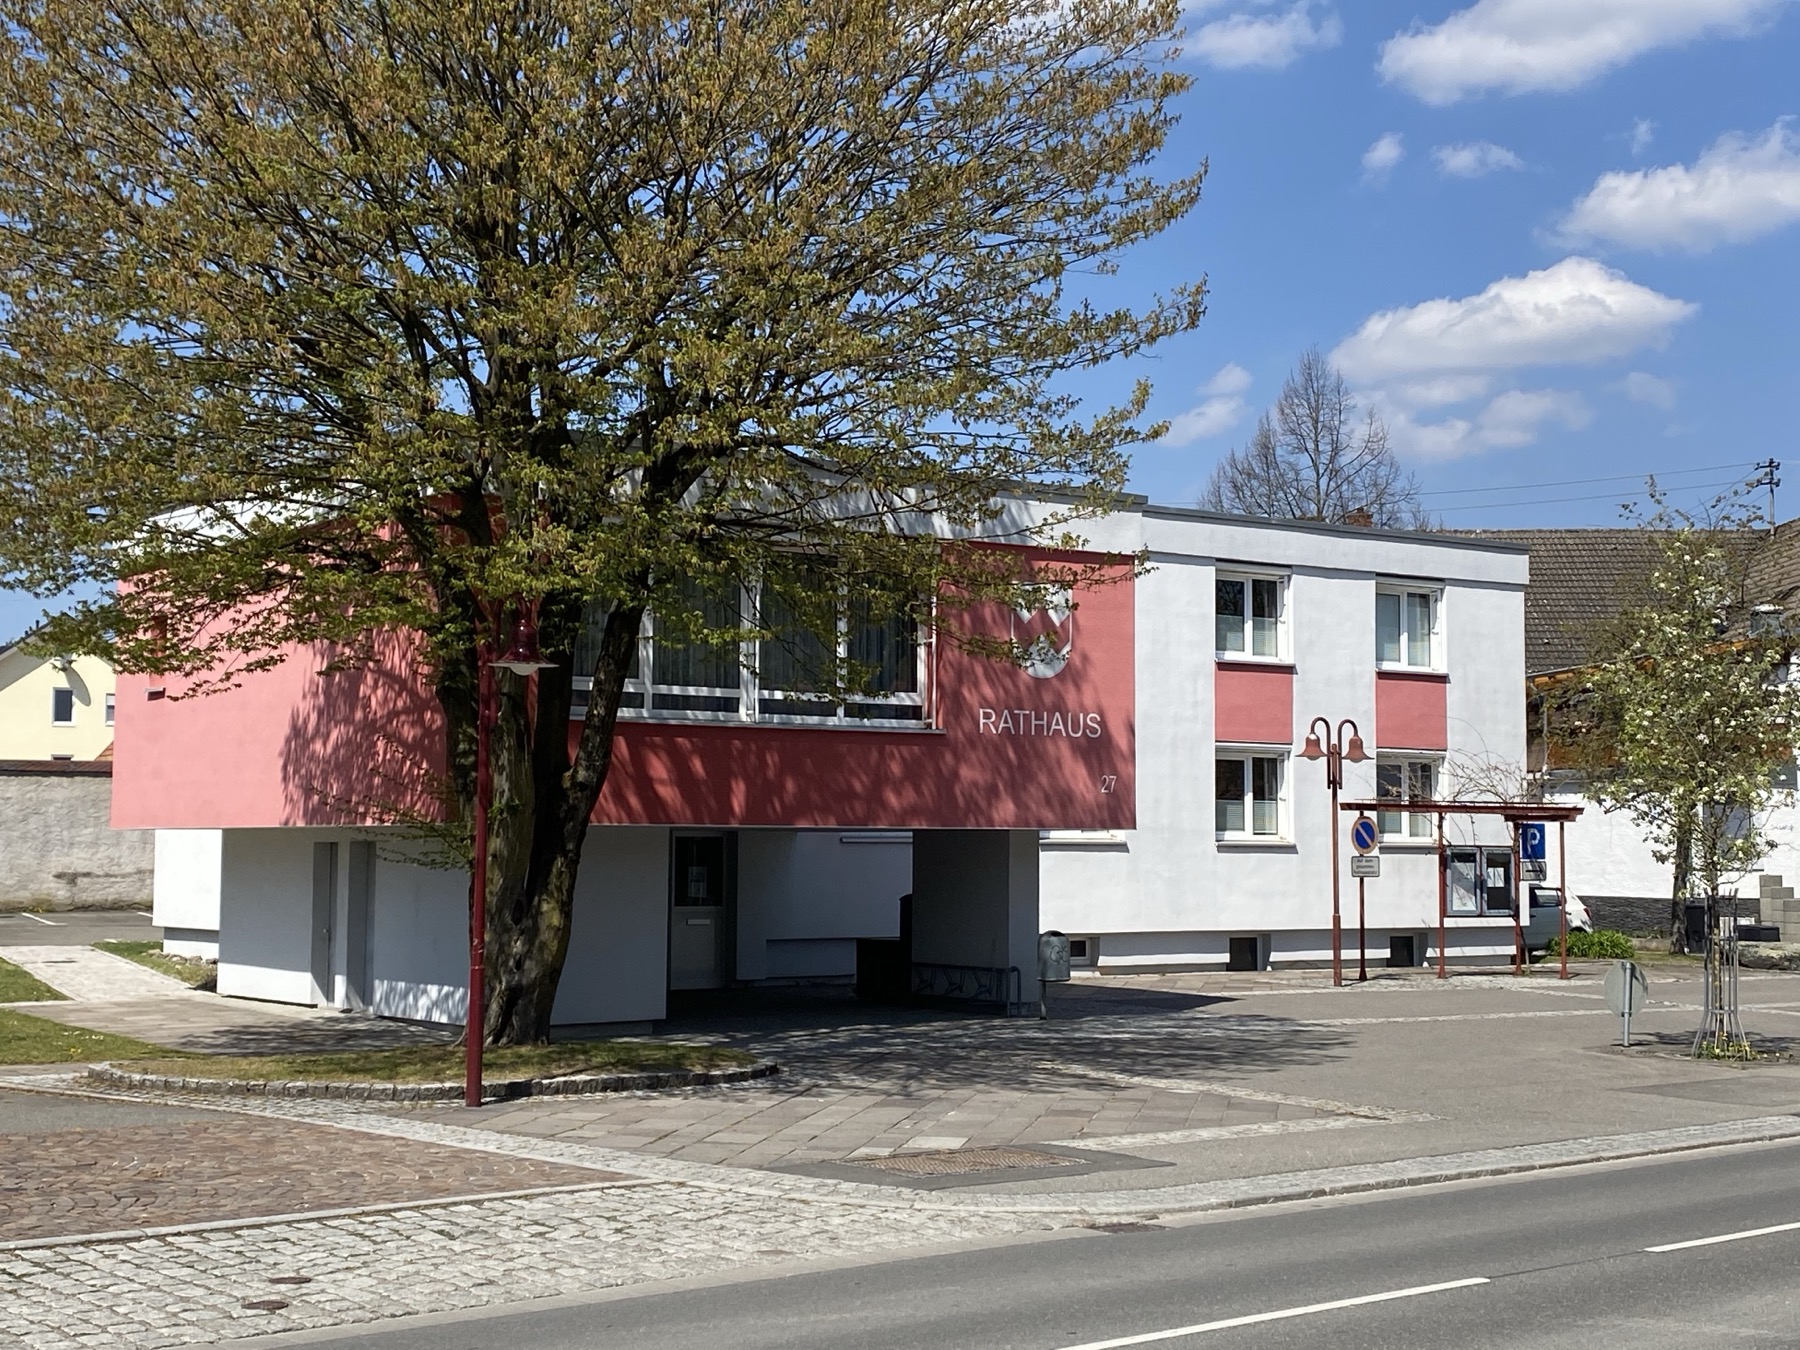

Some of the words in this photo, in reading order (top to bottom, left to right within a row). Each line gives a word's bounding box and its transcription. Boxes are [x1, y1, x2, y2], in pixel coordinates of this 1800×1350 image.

[979, 708, 1102, 738] RATHAUS
[1101, 775, 1117, 793] 27
[1527, 827, 1541, 855] P
